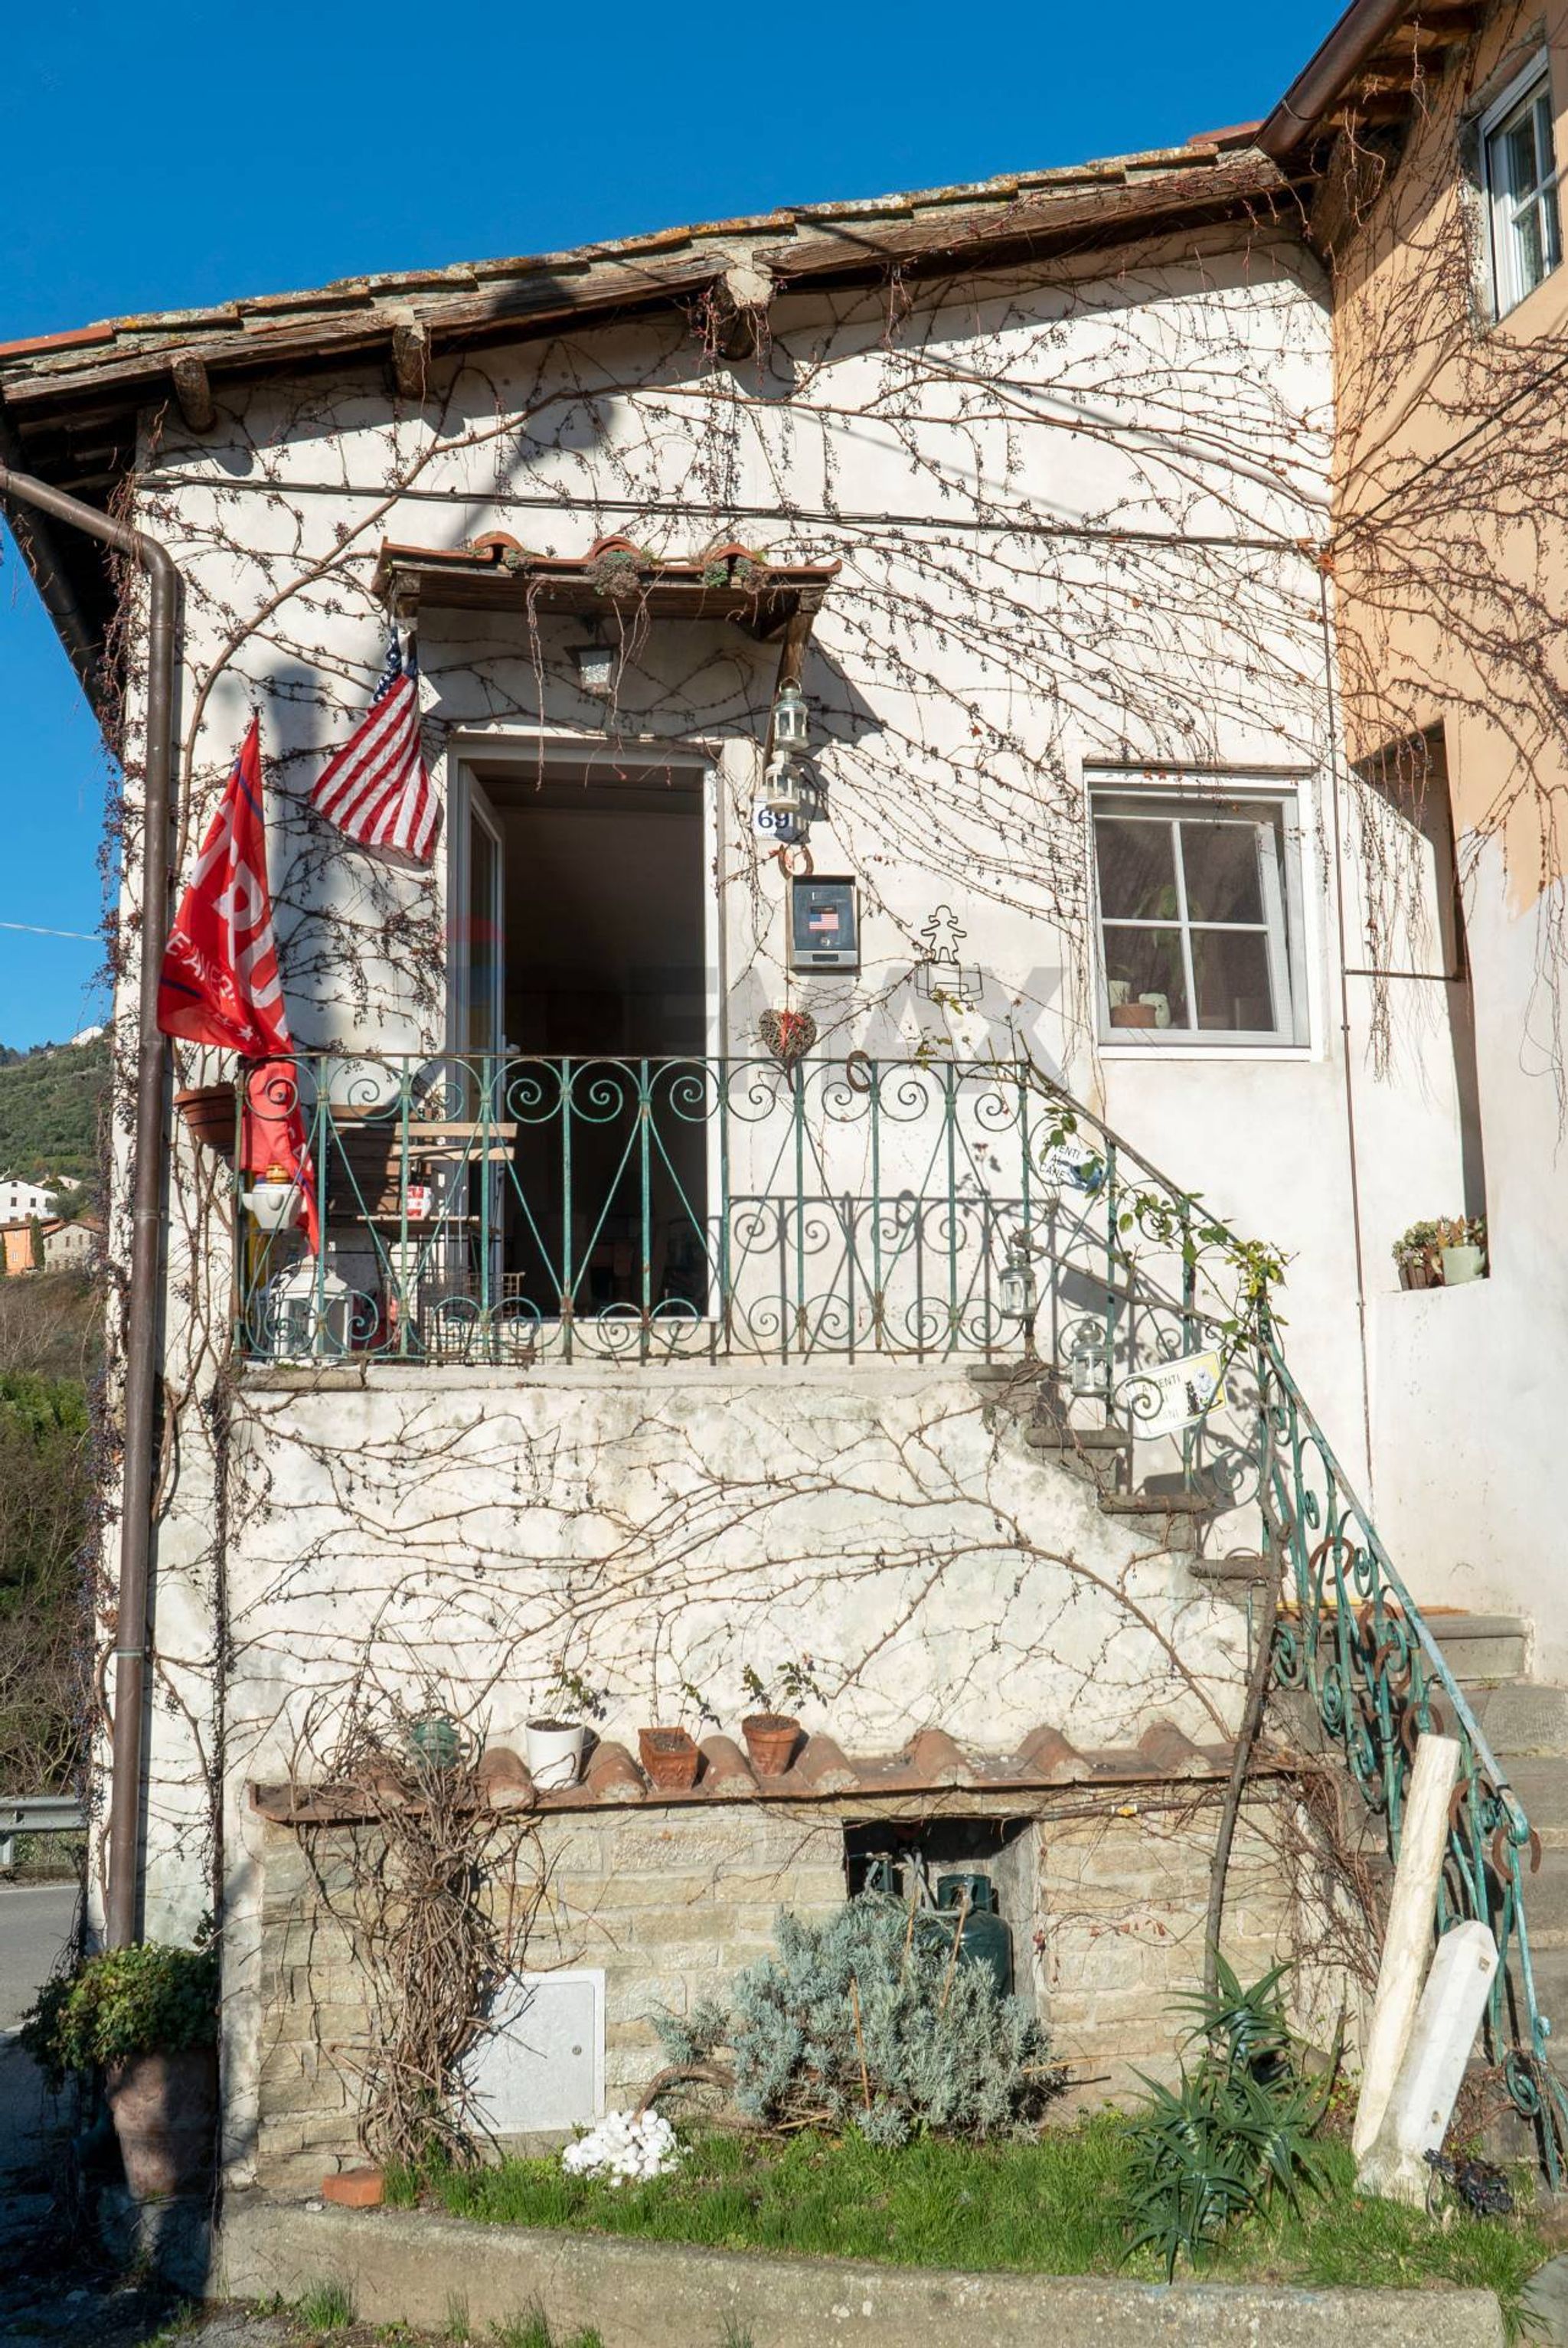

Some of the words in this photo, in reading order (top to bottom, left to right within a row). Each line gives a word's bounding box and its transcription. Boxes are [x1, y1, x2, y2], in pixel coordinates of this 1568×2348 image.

[758, 808, 789, 829] 69
[1054, 1143, 1080, 1161] ENTI
[1039, 1163, 1066, 1177] CANE
